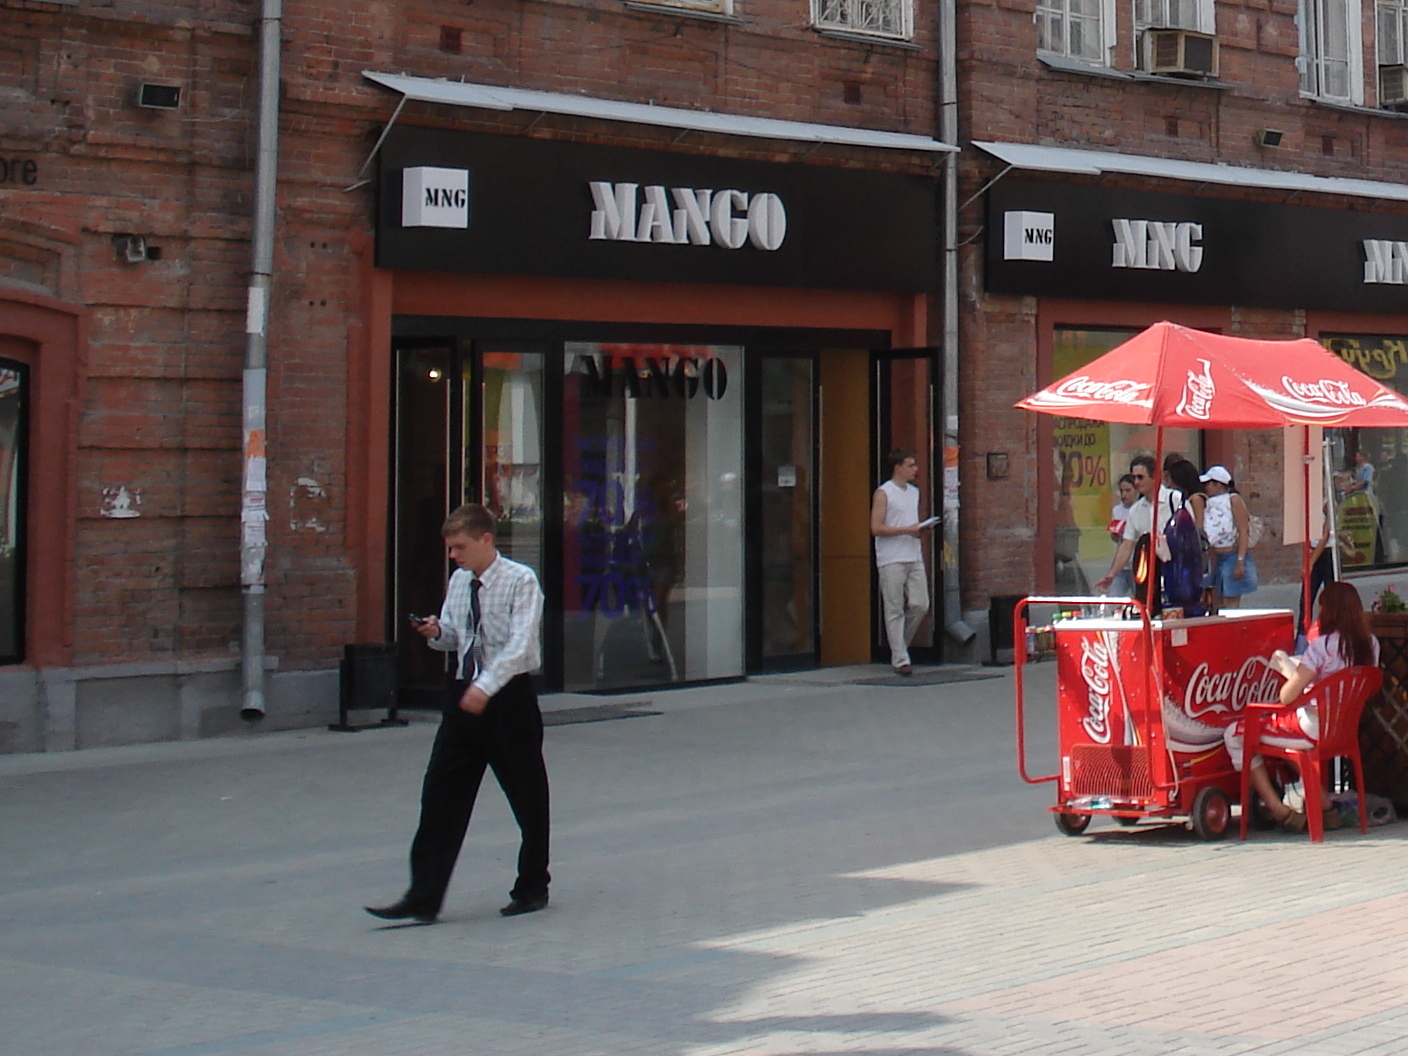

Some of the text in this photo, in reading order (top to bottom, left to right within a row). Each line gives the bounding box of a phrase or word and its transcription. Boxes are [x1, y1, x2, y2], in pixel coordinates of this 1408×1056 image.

[425, 187, 466, 209] MNG
[588, 181, 787, 251] MANGO
[1024, 228, 1053, 245] MNG
[1111, 218, 1203, 273] MNG
[1080, 635, 1112, 745] Coca-Cola
[1184, 654, 1281, 719] Coca-Cola
